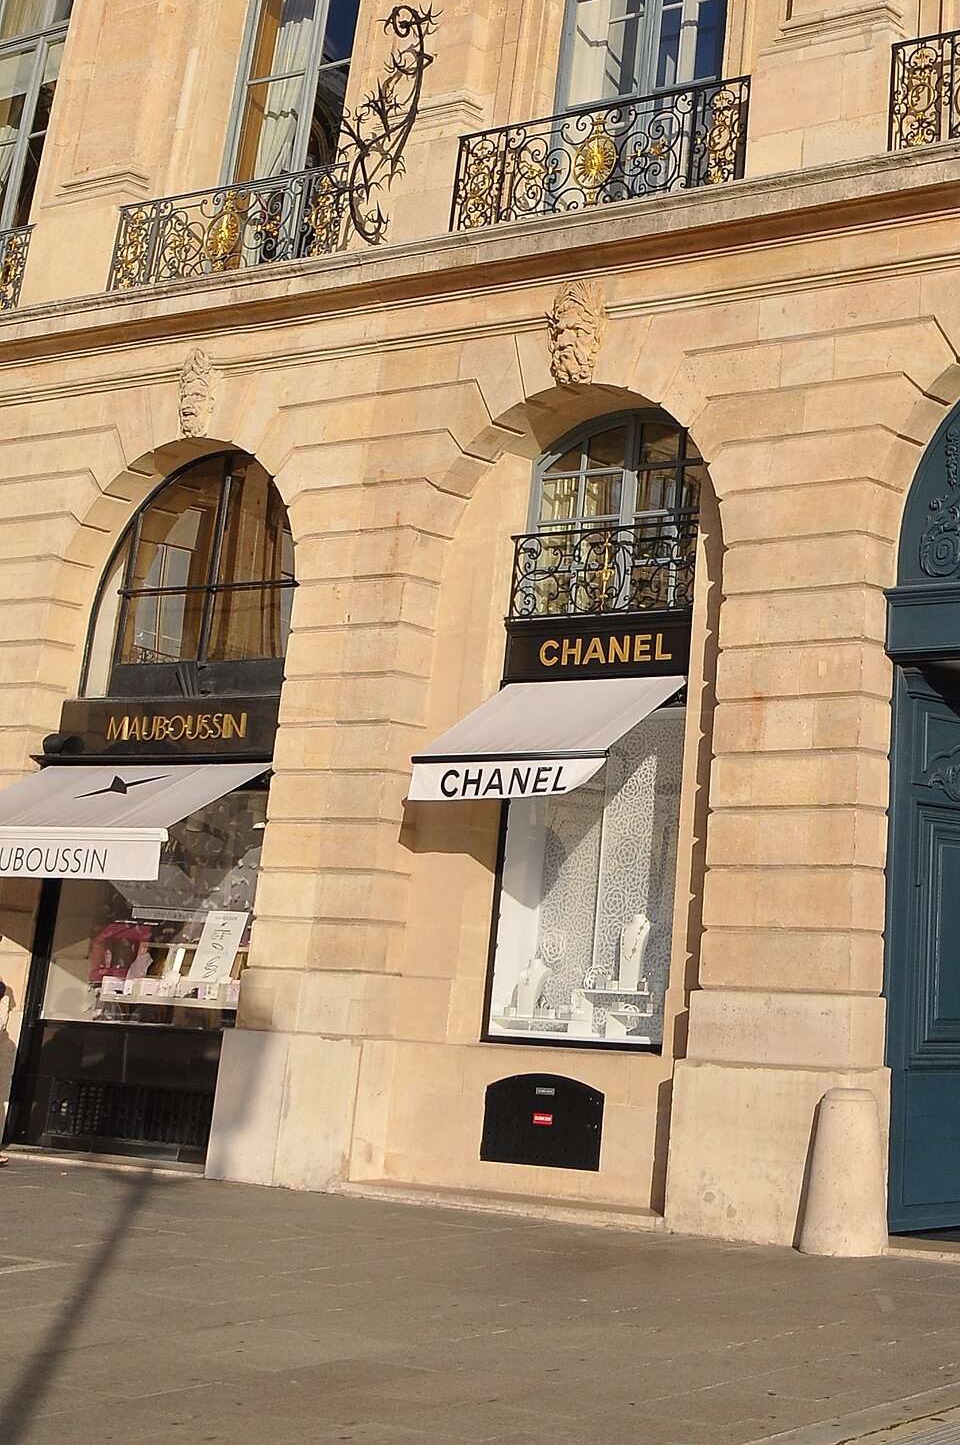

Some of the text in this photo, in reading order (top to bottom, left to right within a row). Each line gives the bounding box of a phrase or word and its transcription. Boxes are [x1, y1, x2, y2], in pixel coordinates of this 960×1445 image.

[539, 633, 672, 667] CHANEL
[106, 712, 248, 741] MAUBOUSSIN
[440, 766, 567, 797] CHANEL
[0, 847, 108, 874] UBOUSSIN
